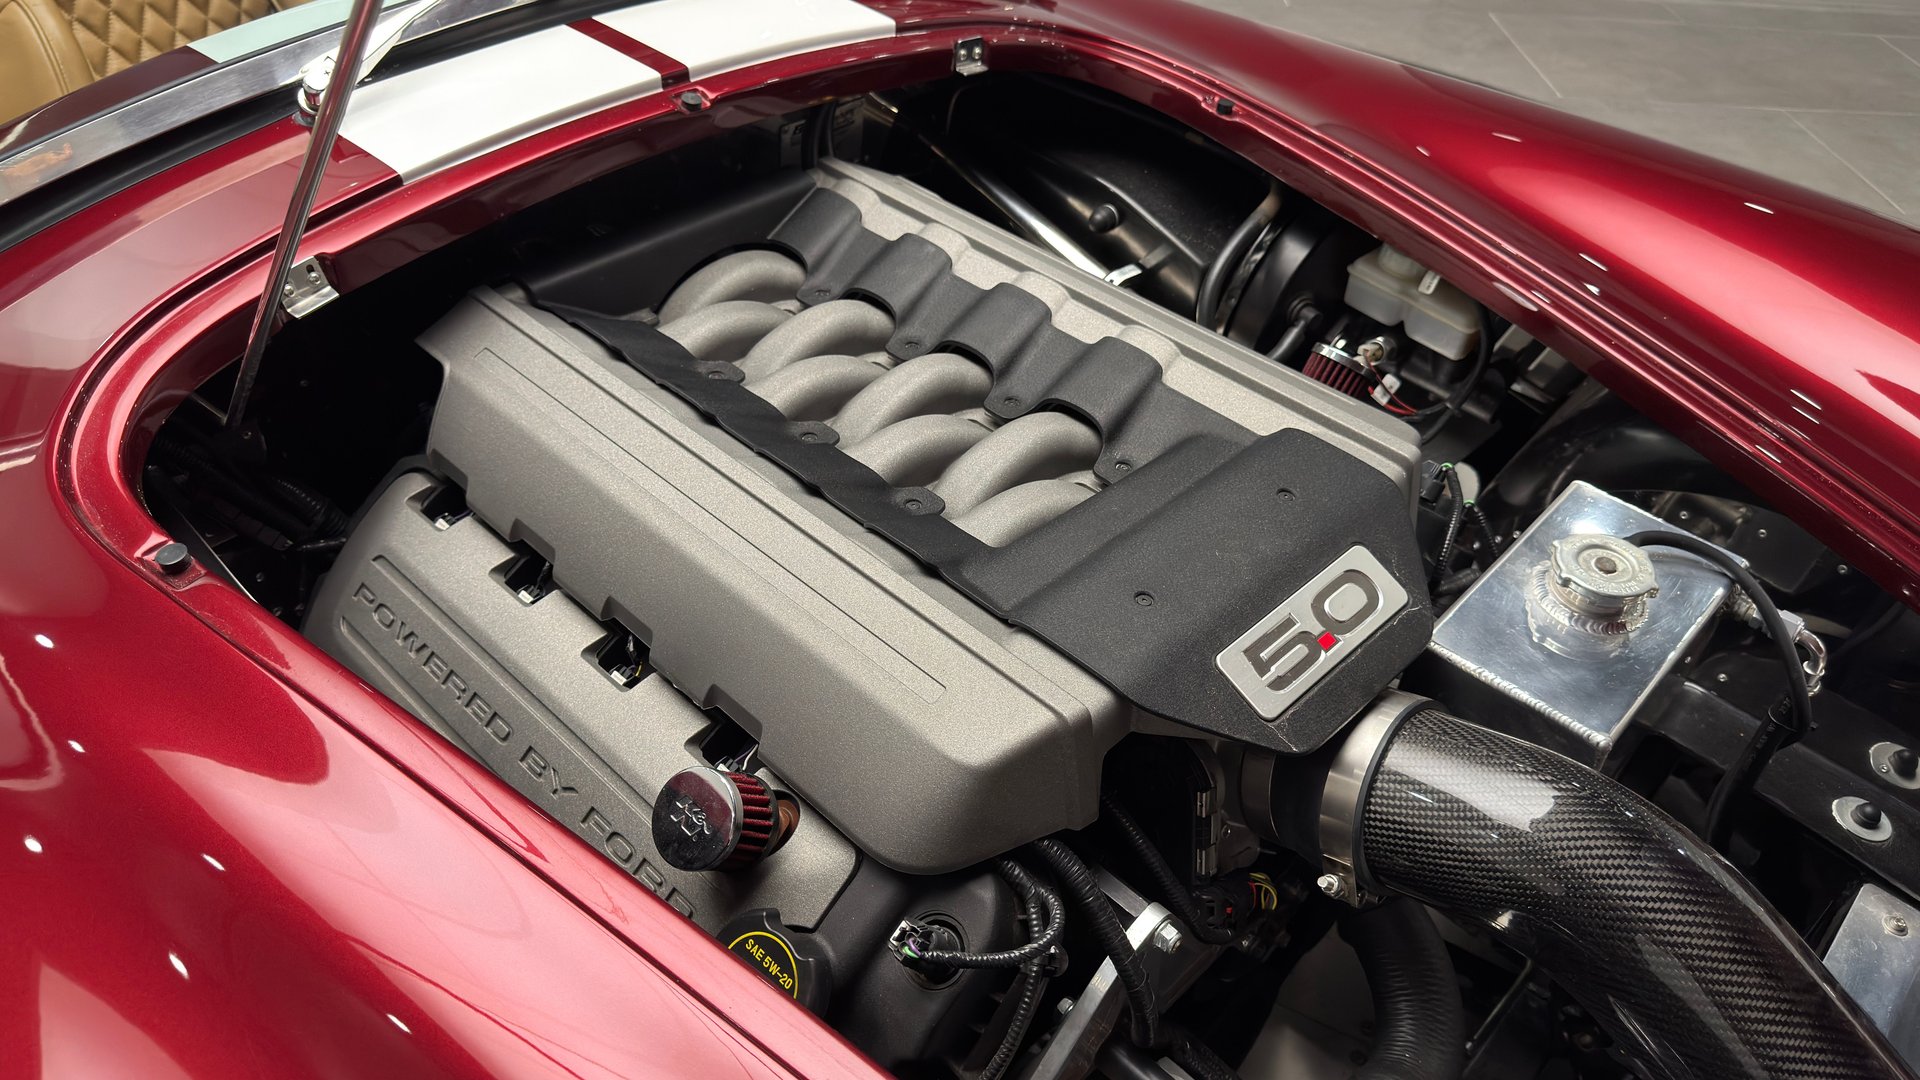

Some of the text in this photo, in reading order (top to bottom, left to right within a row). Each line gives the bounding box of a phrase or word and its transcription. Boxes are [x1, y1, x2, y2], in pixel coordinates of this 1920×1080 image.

[1241, 569, 1384, 694] 5.0
[352, 582, 696, 919] POWERED BY FORD
[745, 939, 793, 989] SAE 5W-20
